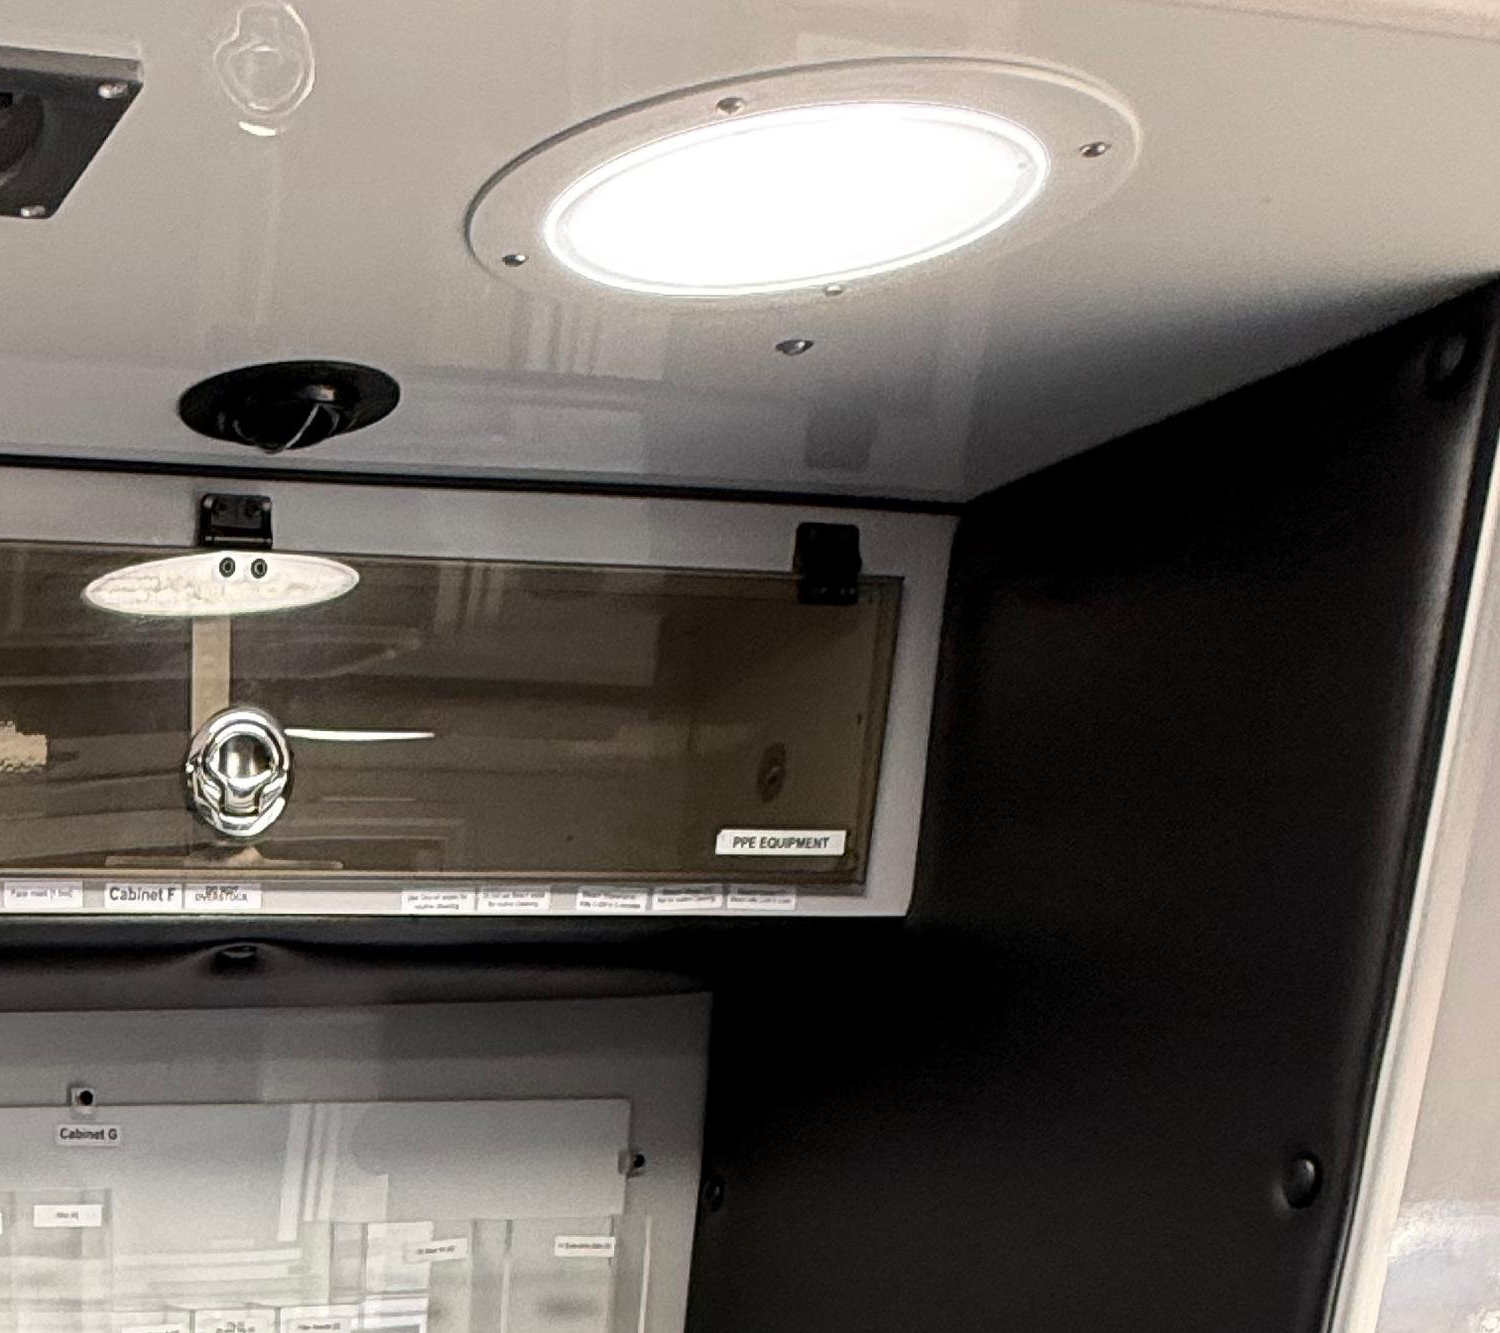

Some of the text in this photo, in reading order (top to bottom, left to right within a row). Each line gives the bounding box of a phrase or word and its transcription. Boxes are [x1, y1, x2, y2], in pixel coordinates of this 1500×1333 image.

[732, 836, 830, 849] PPE EQUIPMENT
[109, 886, 176, 902] Cabinet F
[59, 1127, 118, 1141] Cabinet G
